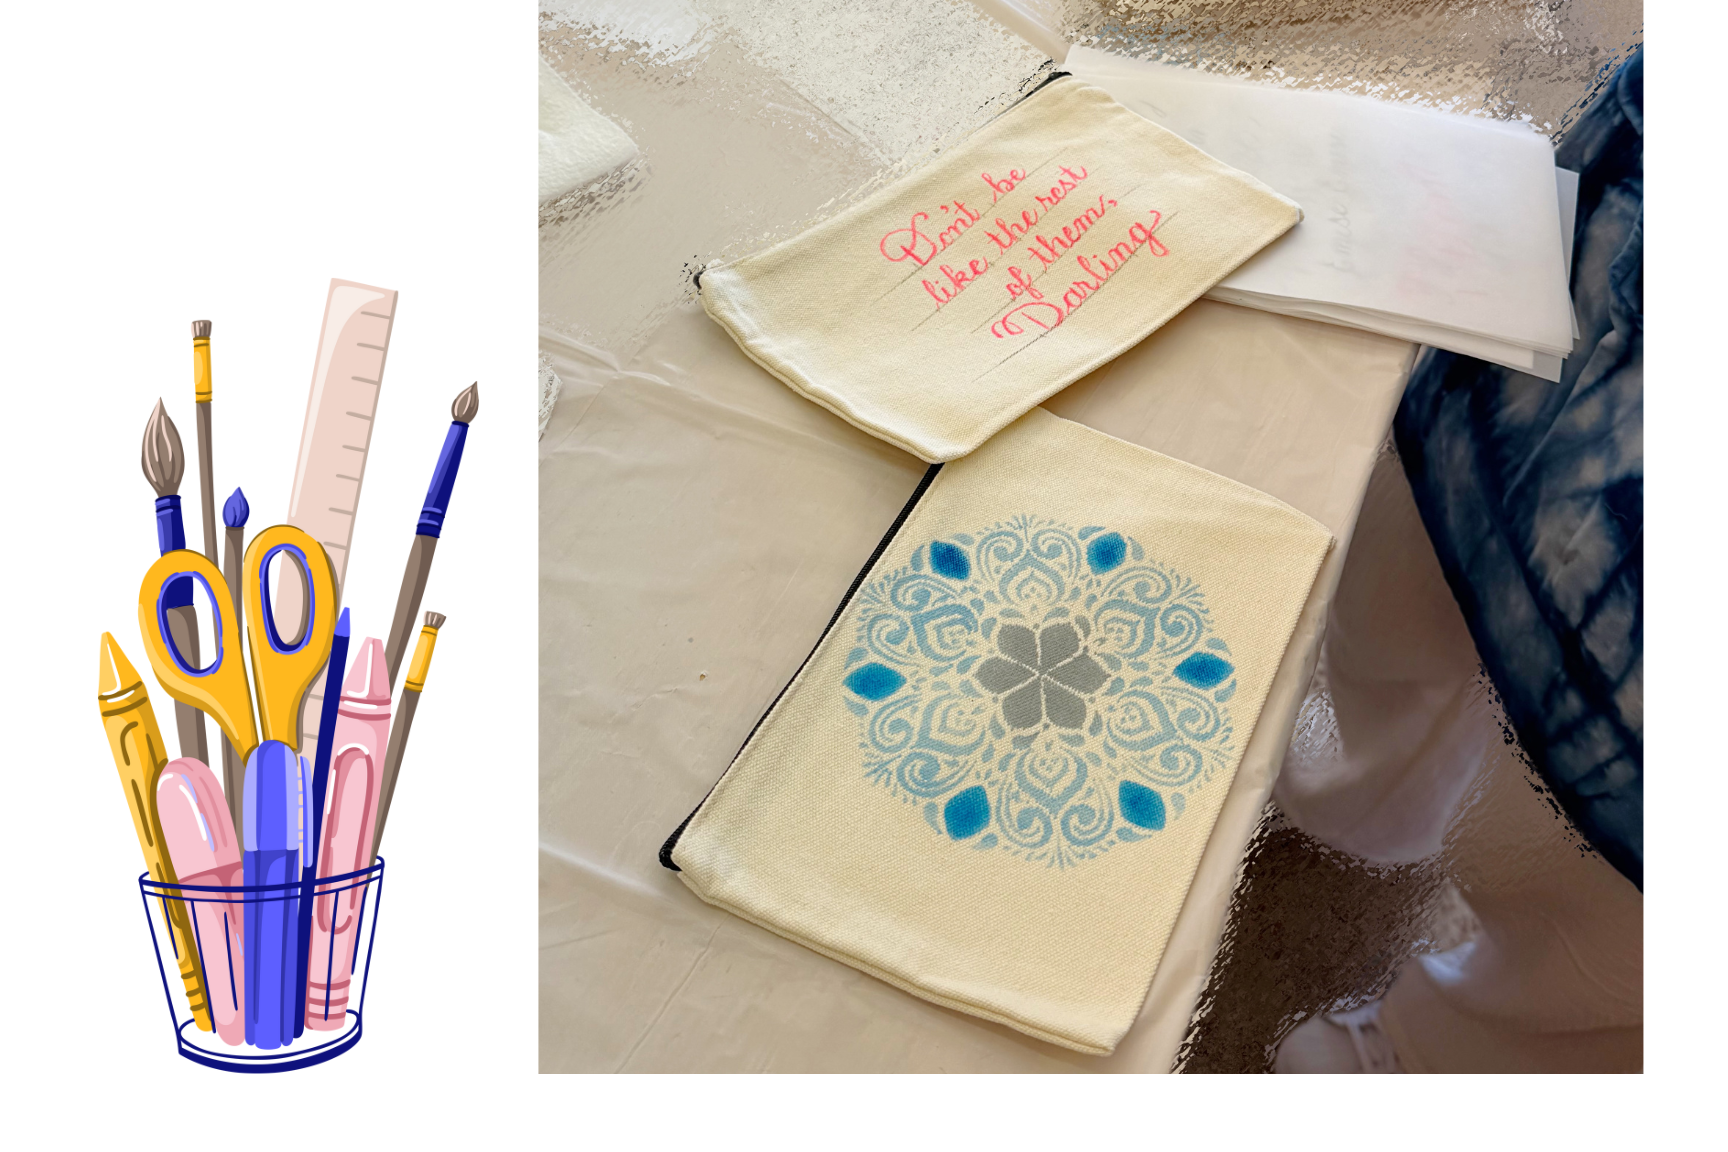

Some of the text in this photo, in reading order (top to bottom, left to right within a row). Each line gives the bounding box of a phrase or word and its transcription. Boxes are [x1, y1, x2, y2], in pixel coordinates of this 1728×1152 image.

[880, 167, 1027, 266] Don't be
[921, 165, 1088, 311] like the rest
[991, 209, 1171, 339] Darling
[1006, 265, 1045, 301] of
